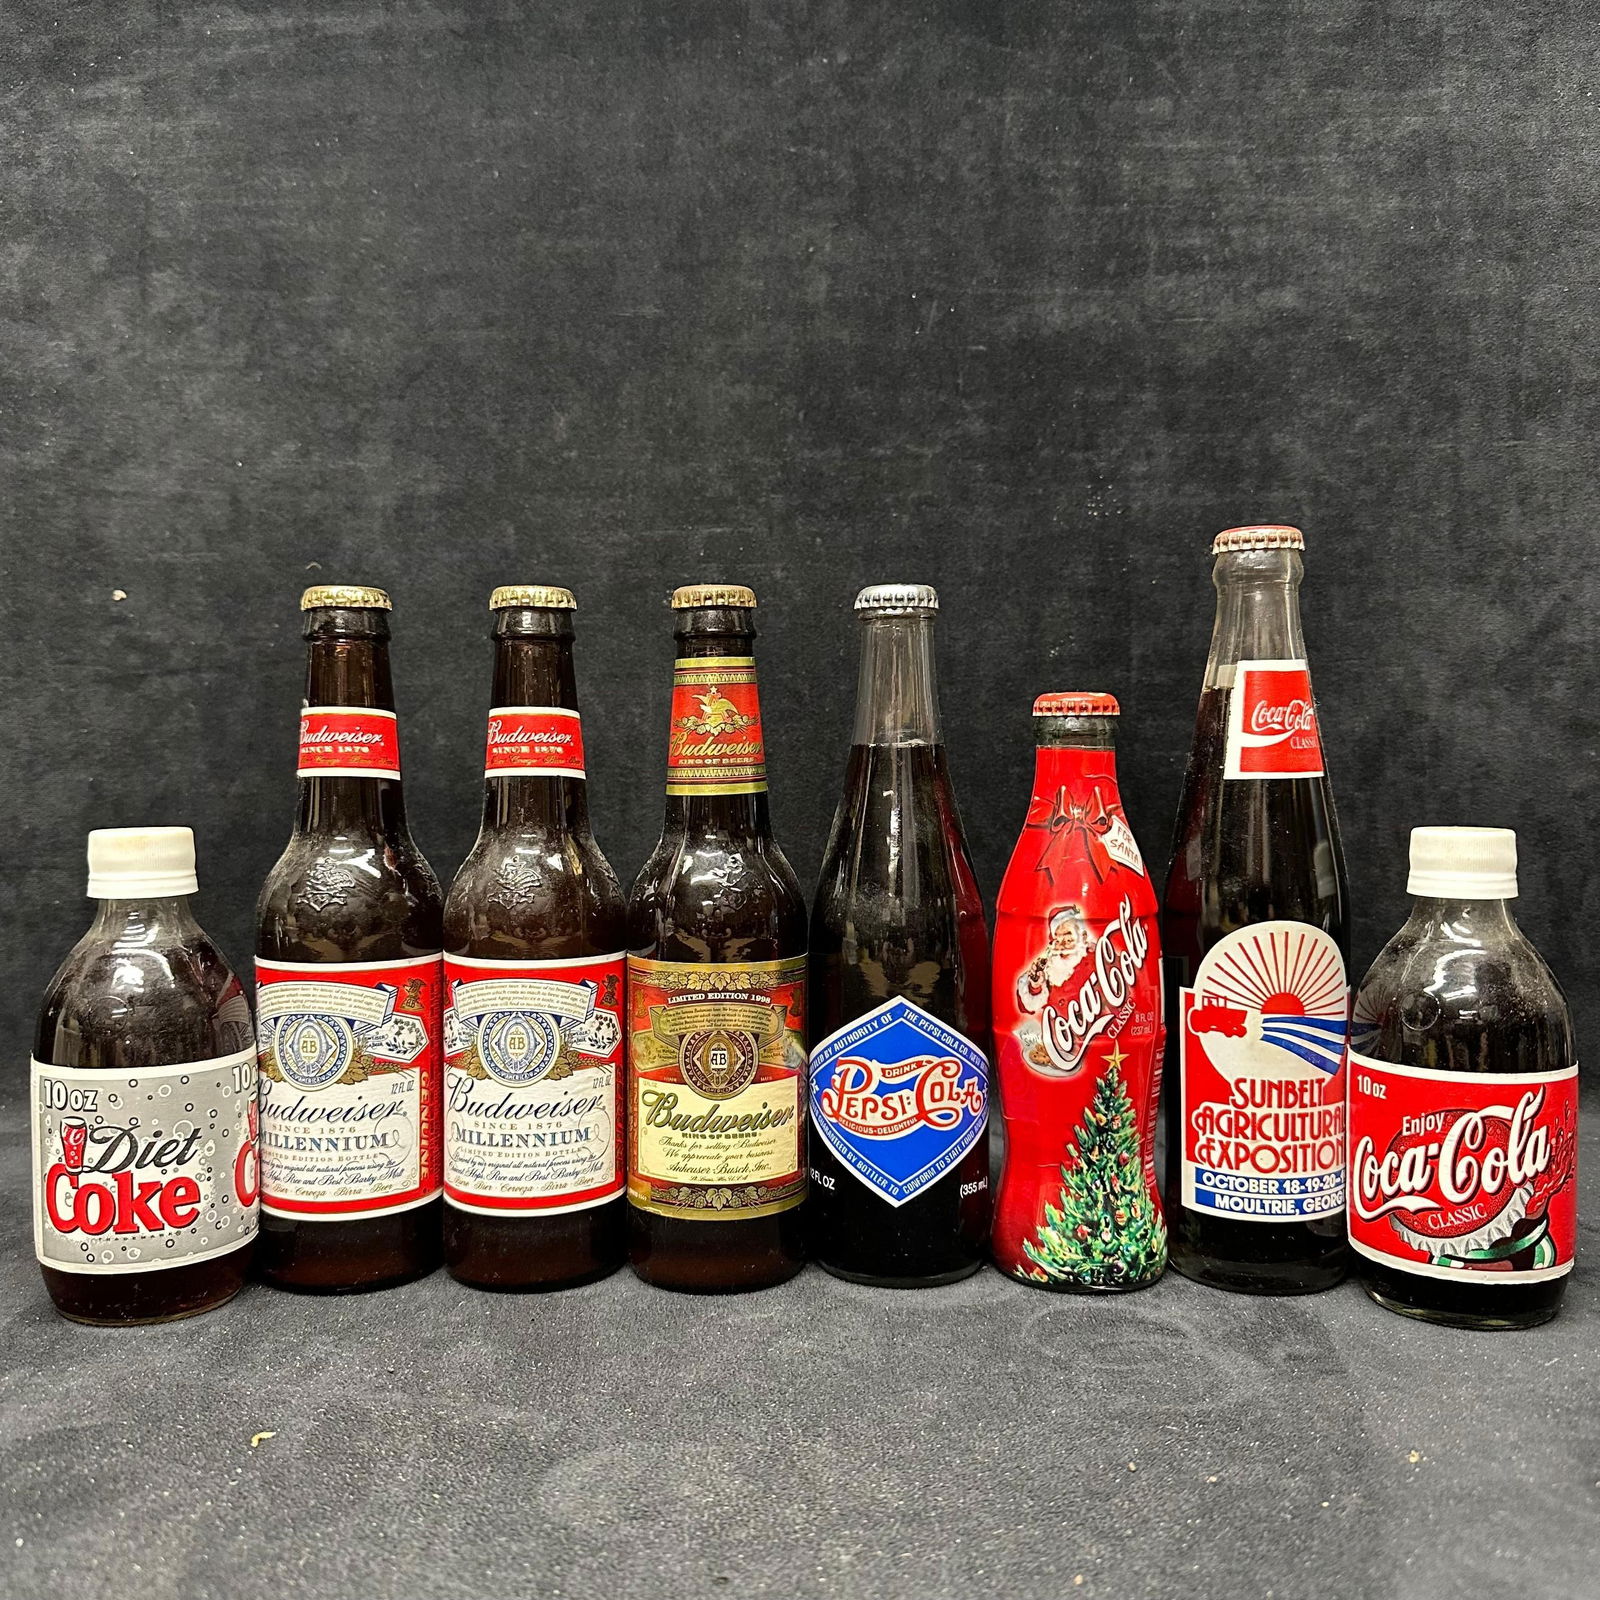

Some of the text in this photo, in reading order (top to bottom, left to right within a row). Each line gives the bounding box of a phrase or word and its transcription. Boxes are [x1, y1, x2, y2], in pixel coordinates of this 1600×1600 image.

[488, 720, 572, 744] Budweiser
[671, 731, 761, 757] Budweiser
[1290, 736, 1319, 749] CLASSI
[493, 746, 530, 754] SINCE
[1117, 825, 1134, 845] FOR
[1110, 838, 1139, 864] SANTA
[667, 992, 771, 1004] LIMITED EDITION 1998
[1107, 997, 1136, 1039] CLASSIC
[823, 1047, 834, 1059] BY
[833, 1020, 879, 1051] AUTHORITY
[880, 1012, 893, 1025] OF
[903, 1008, 918, 1023] THE
[918, 1019, 959, 1048] PEPSI-COLA
[958, 1045, 969, 1057] CO.
[711, 1053, 727, 1066] AB
[885, 1062, 917, 1078] DRINK
[232, 1062, 251, 1094] 10
[1357, 1074, 1371, 1095] 10
[43, 1079, 67, 1110] 10
[447, 1074, 603, 1120] Budweiser
[1230, 1077, 1325, 1109] SUNBELT
[642, 1089, 795, 1132] Budweiser
[1194, 1105, 1345, 1142] AGRICULTURAL
[272, 1124, 357, 1134] SINCE 1876
[420, 1072, 430, 1180] GENUINE
[452, 1123, 591, 1149] MILLENNIUM
[474, 1121, 563, 1131] SINCE 1876
[1402, 1112, 1446, 1136] Enjoy
[82, 1125, 202, 1174] Diet
[497, 1151, 540, 1160] EDITION
[545, 1148, 582, 1158] BOTTLE
[659, 1136, 687, 1149] Thanks
[688, 1141, 702, 1152] for
[705, 1142, 731, 1152] selling
[663, 1147, 679, 1158] We
[681, 1153, 722, 1162] appreciate
[724, 1154, 743, 1163] your
[817, 1114, 899, 1196] GUARANTEED BY BOTTLER TO
[1197, 1136, 1345, 1174] EXPOSITION
[1353, 1084, 1551, 1220] Coca-Cola
[488, 1161, 513, 1171] original
[902, 1169, 936, 1194] CONFORM
[935, 1162, 946, 1173] TO
[945, 1146, 962, 1164] STATE
[961, 1132, 975, 1149] FOOD
[815, 1171, 822, 1185] FL
[822, 1177, 835, 1191] OZ
[959, 1181, 978, 1199] (355
[1202, 1172, 1279, 1194] OCTOBER
[46, 1163, 201, 1235] Coke
[1214, 1189, 1345, 1215] MOULTRIE, GEORGI
[1427, 1203, 1488, 1231] CLASSIC
